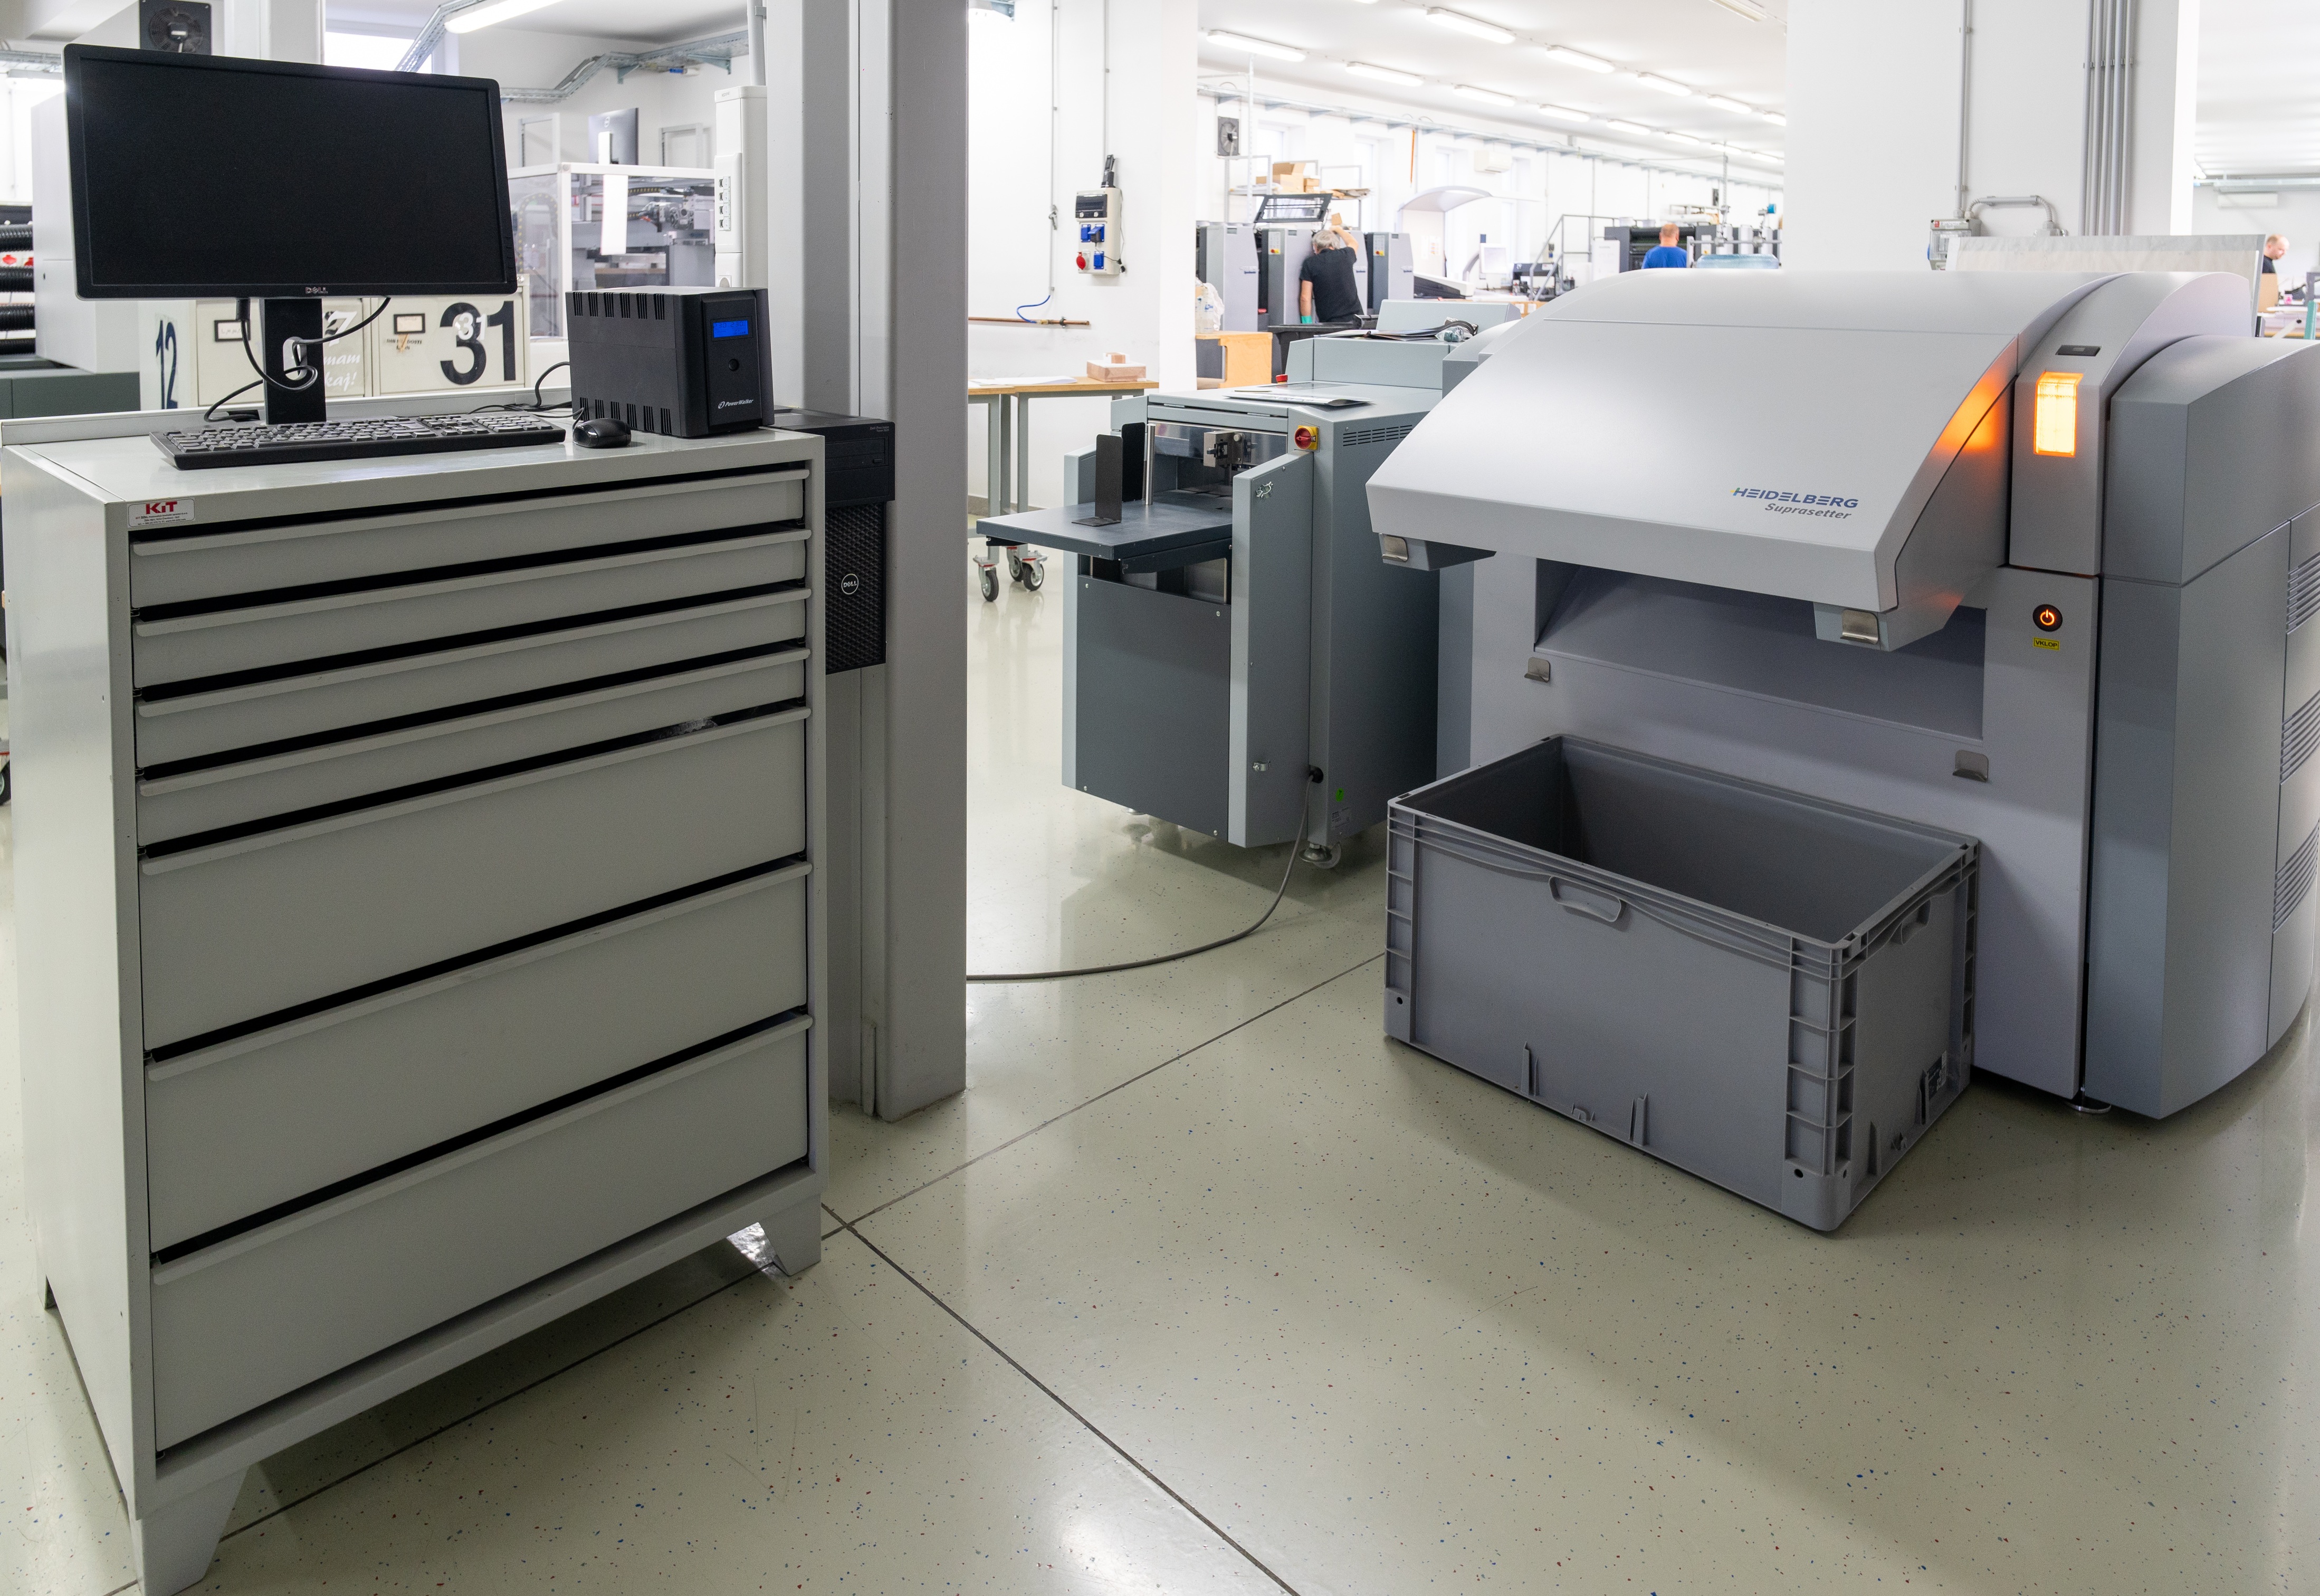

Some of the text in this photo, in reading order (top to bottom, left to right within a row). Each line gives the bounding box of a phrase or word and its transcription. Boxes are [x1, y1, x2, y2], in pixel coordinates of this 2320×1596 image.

[458, 312, 488, 340] 31
[440, 300, 516, 386] 31
[156, 320, 178, 409] 12
[1730, 487, 1859, 508] HEIDELBERG
[1764, 503, 1852, 519] Suprasetter
[2035, 639, 2058, 648] VKLOP
